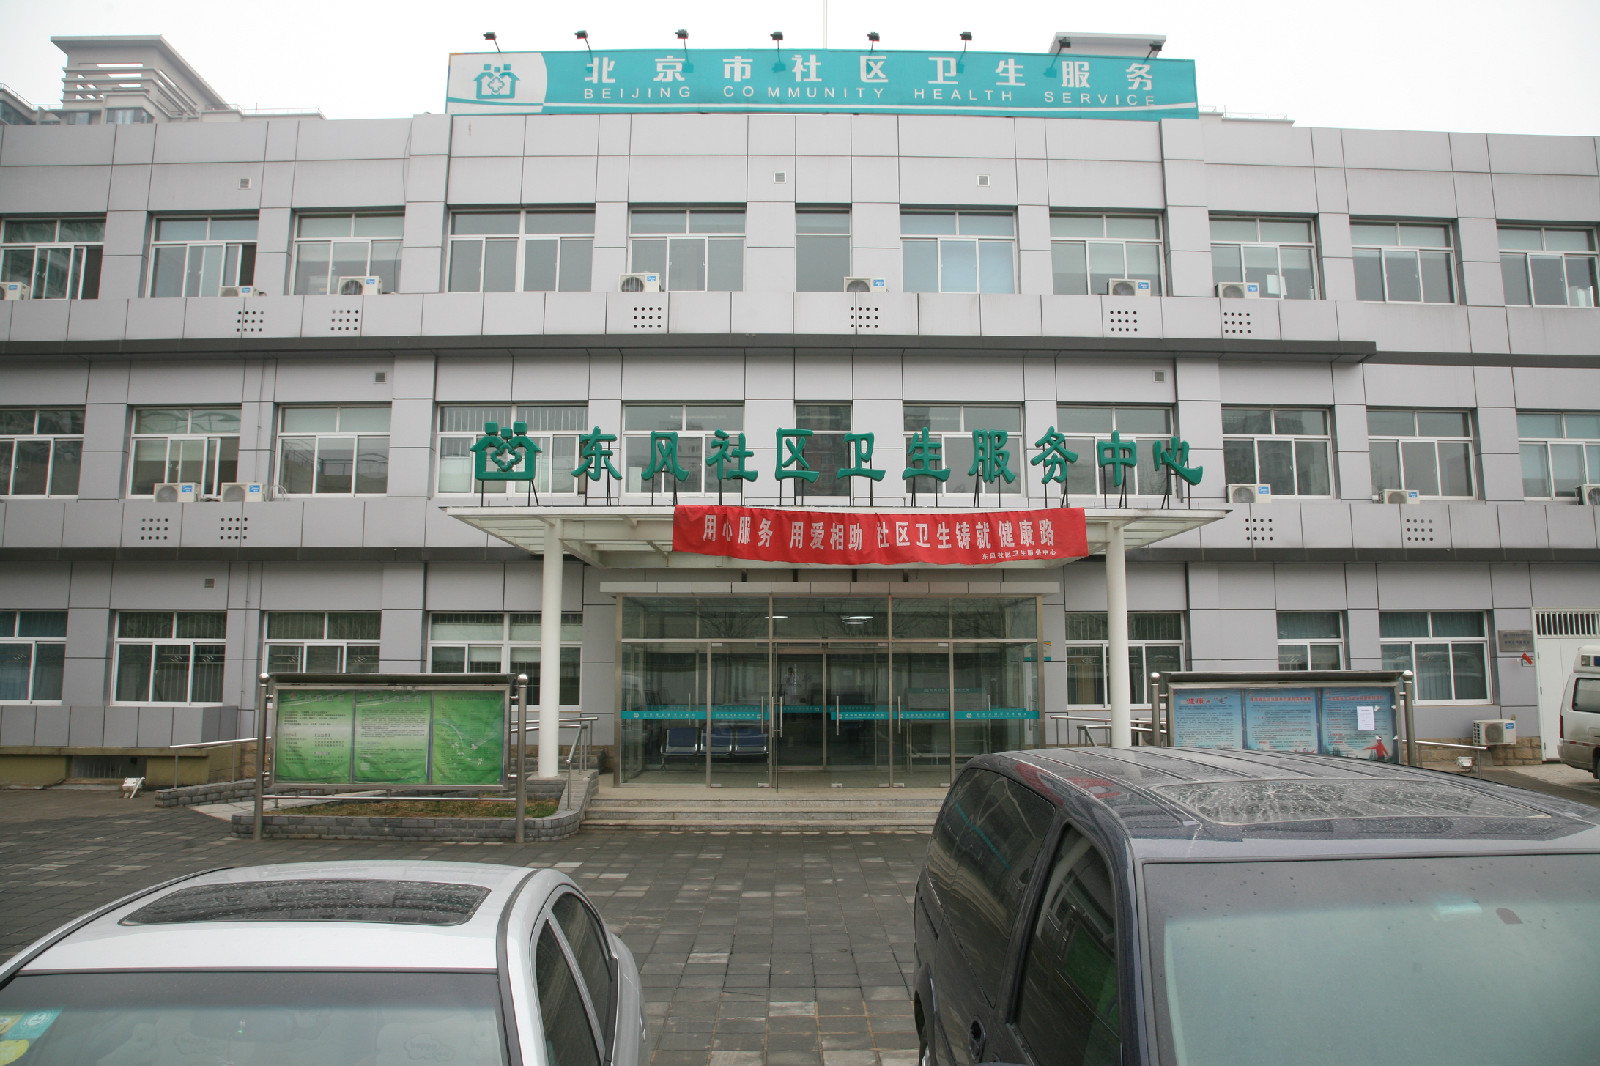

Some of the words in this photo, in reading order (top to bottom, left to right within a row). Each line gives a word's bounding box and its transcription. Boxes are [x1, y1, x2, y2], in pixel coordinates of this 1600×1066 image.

[584, 54, 1153, 91] 北京市社区卫生服务
[584, 86, 690, 99] BEIJING
[914, 88, 1013, 102] HEALTH
[1044, 91, 1155, 106] SERVICE
[571, 426, 1204, 487] 东风社区卫生服务中心
[789, 522, 863, 551] 用爱相助
[877, 518, 1054, 550] 社区卫生铸就健康路
